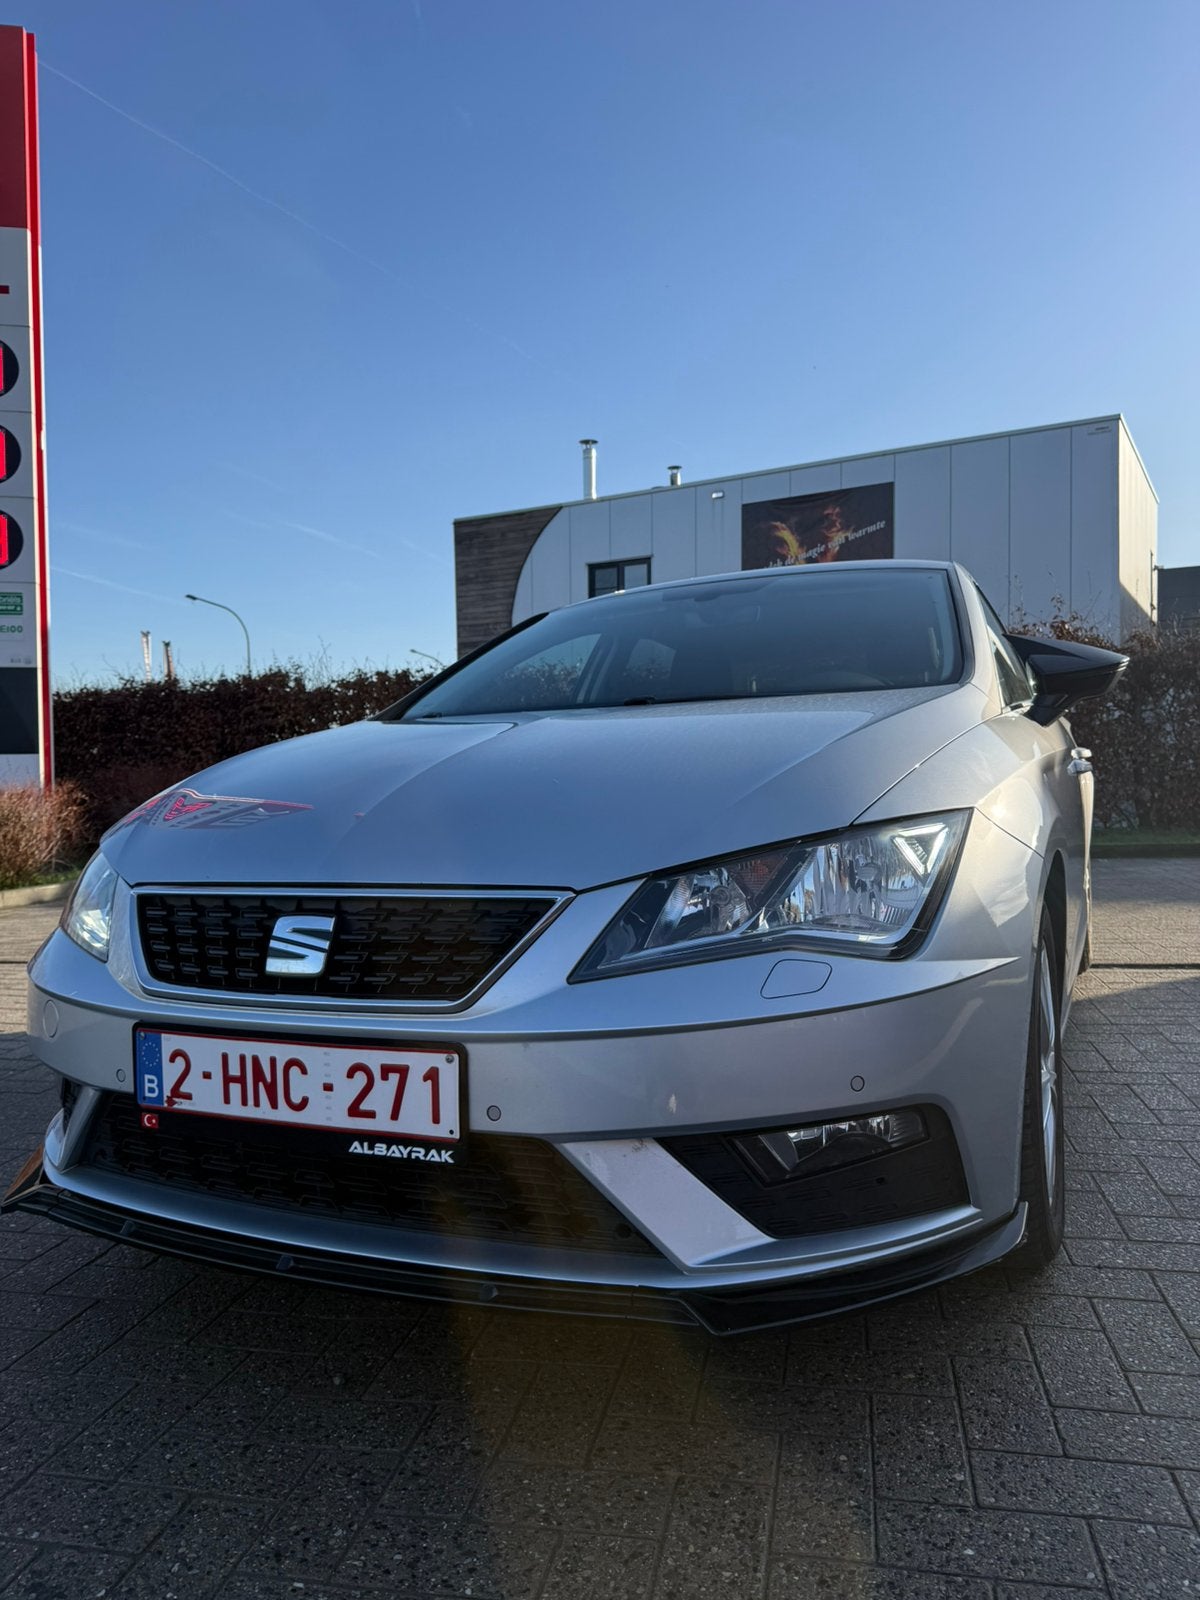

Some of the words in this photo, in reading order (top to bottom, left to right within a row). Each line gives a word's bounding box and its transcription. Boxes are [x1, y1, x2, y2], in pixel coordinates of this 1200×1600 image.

[797, 543, 827, 561] magie
[827, 535, 846, 549] van
[848, 520, 886, 541] warmte
[144, 1074, 159, 1098] B
[168, 1048, 441, 1125] 2-HNC-271
[348, 1140, 455, 1164] ALBAYRAK
